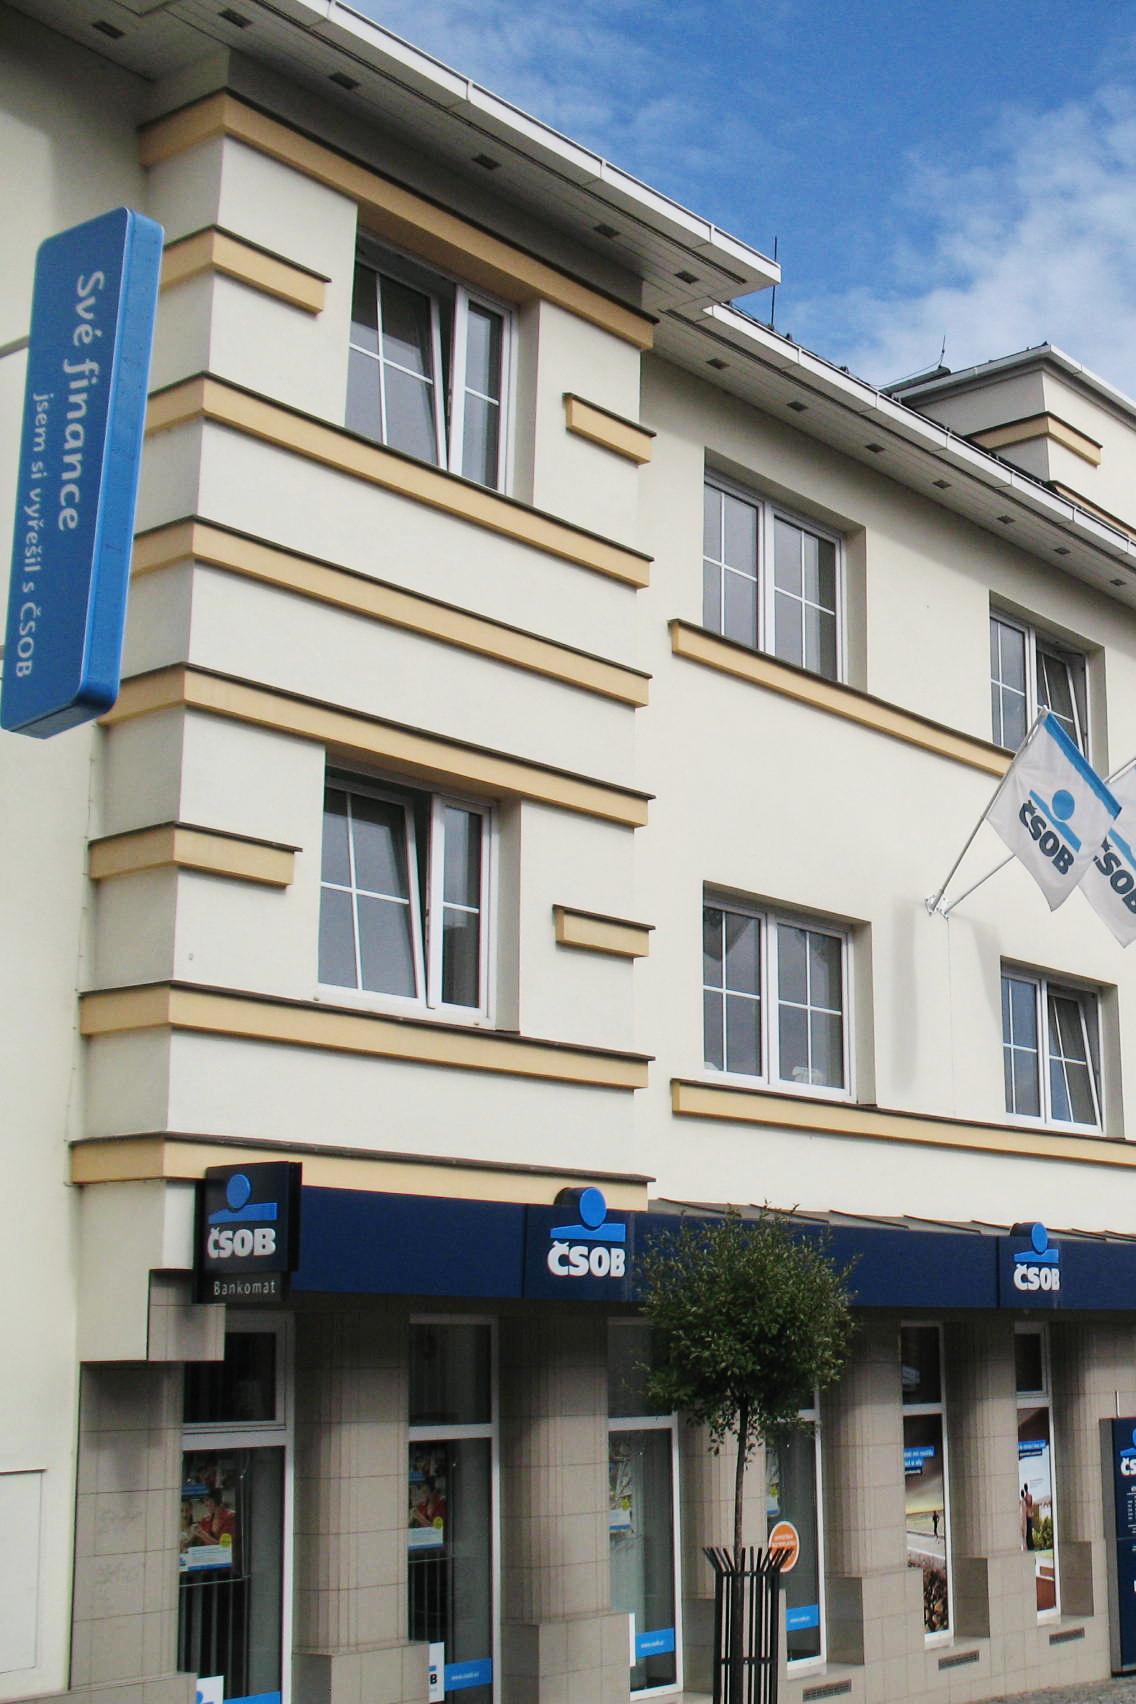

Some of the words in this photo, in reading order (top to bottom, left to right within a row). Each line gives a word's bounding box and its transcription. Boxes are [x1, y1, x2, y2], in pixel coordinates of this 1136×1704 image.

[73, 271, 104, 346] Své
[33, 393, 54, 451] jsem
[58, 358, 101, 531] finance
[31, 461, 48, 479] si
[24, 488, 45, 571] vyřešil
[22, 582, 34, 593] s
[16, 602, 41, 678] ČSOB
[1019, 800, 1075, 875] ČSOB
[207, 1227, 276, 1258] ČSOB
[547, 1240, 626, 1277] ČSOB
[213, 1280, 276, 1296] Bankomat
[1013, 1263, 1060, 1291] ČSOB
